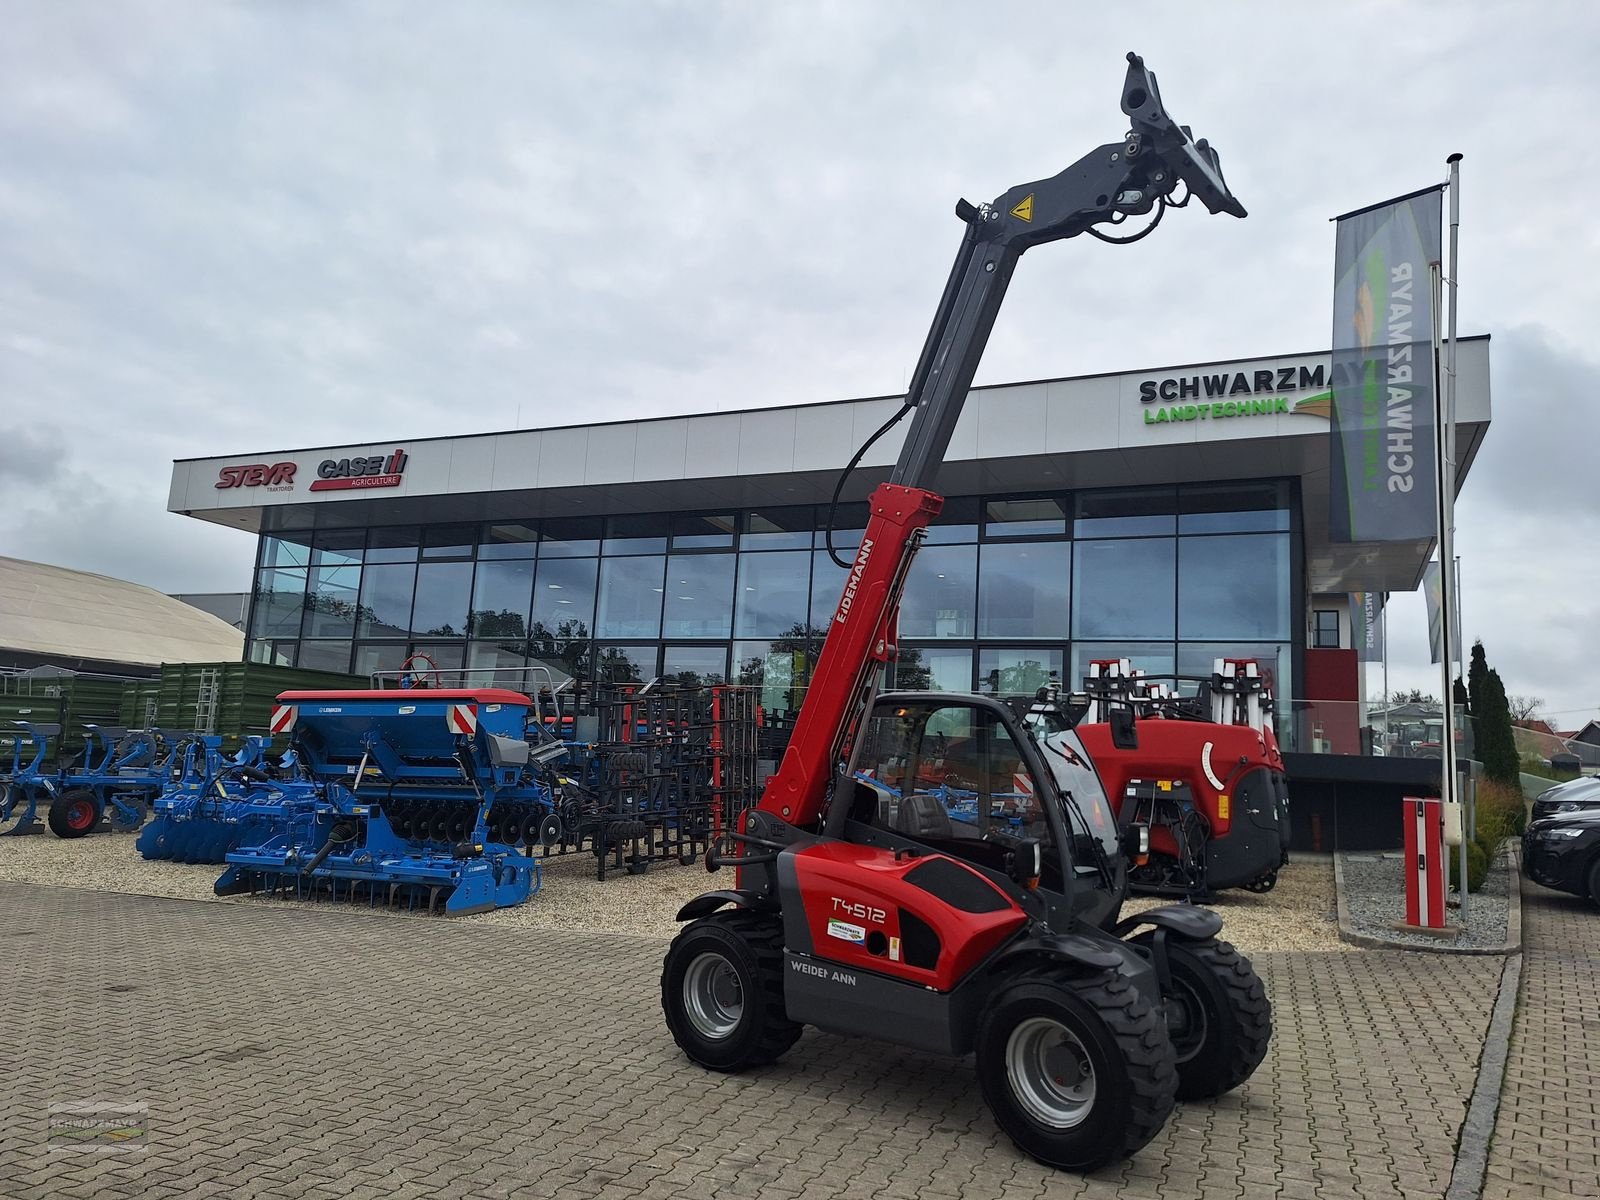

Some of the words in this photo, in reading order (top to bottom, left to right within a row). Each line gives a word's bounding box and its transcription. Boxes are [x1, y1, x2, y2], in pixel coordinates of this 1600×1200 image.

[1138, 358, 1388, 403] SCHWARZMAY
[1143, 397, 1289, 425] LANDTECHNIK
[215, 462, 297, 488] STEYR
[317, 456, 384, 479] CASE
[351, 476, 397, 486] AGRICULTURE
[831, 896, 886, 924] T4512
